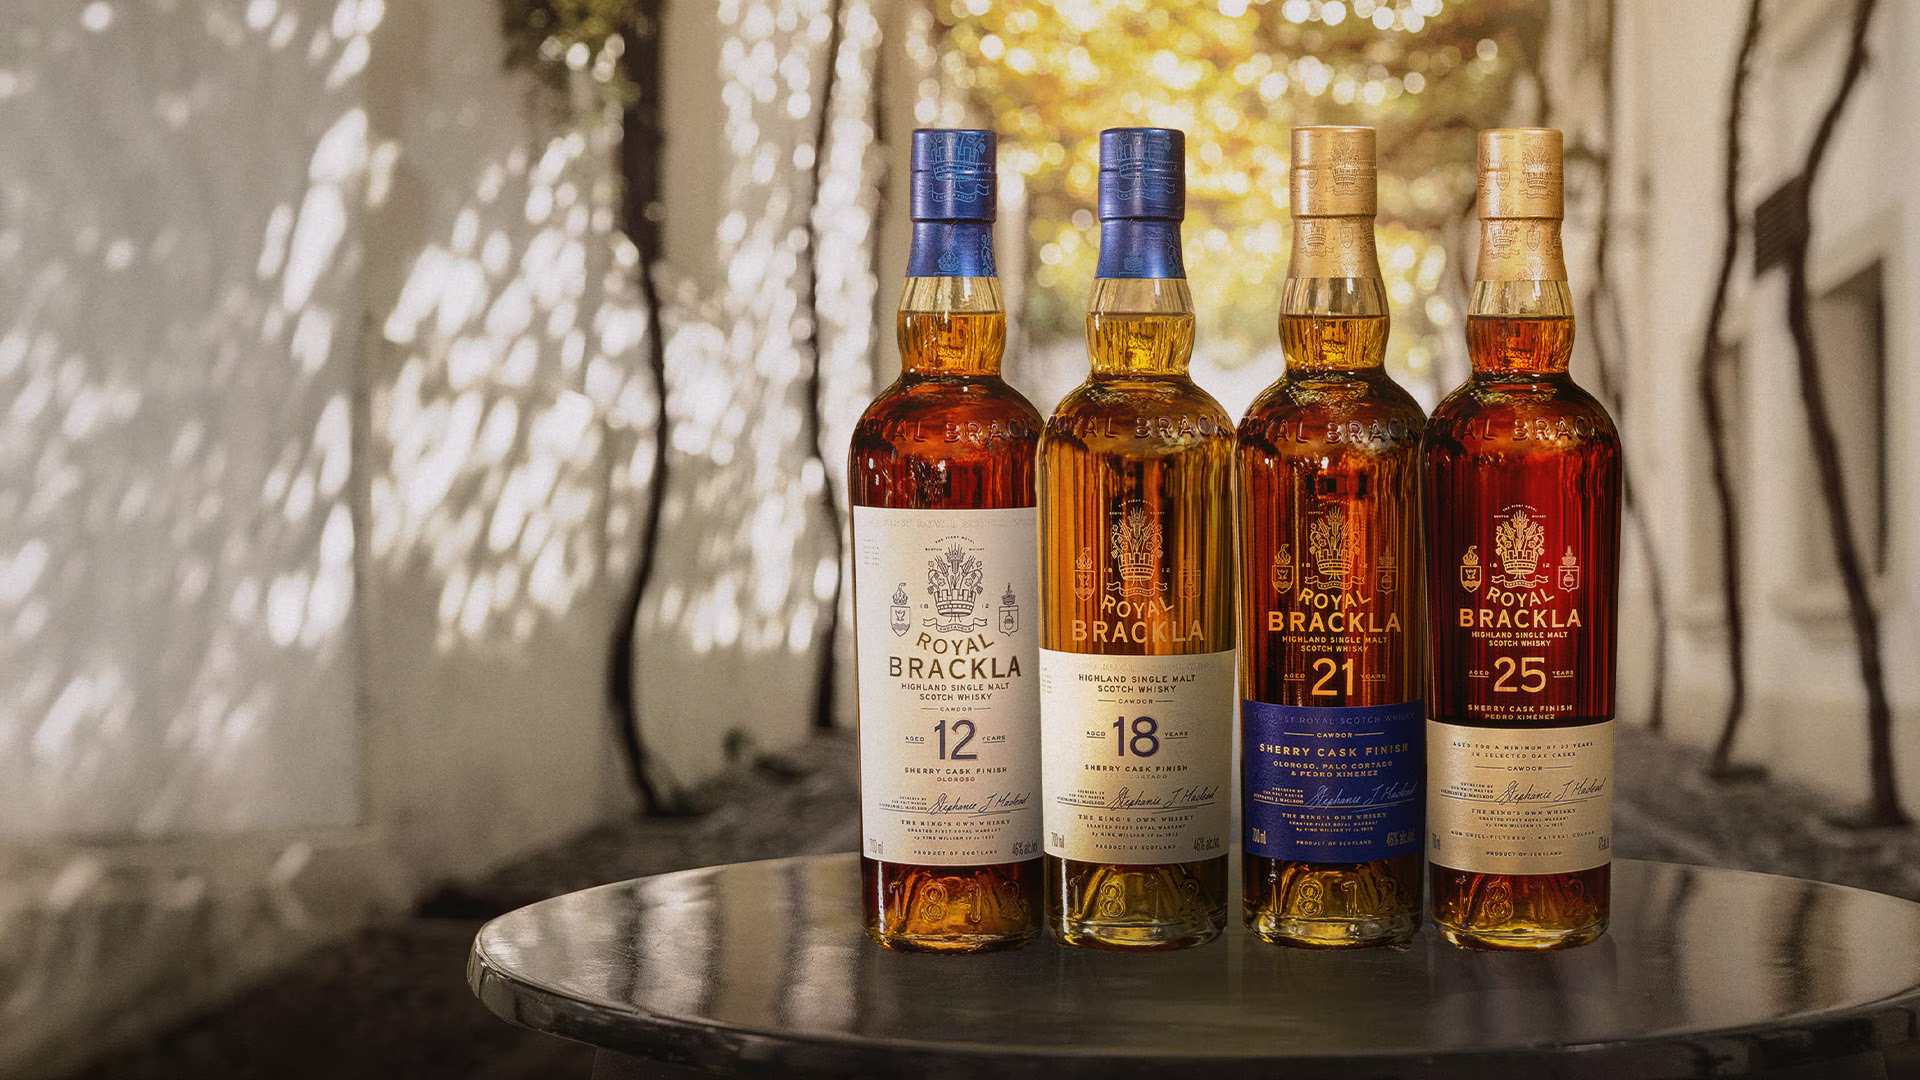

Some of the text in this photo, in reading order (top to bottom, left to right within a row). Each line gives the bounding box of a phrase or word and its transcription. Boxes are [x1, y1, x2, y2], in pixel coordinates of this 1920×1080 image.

[1101, 594, 1174, 619] ROYAL
[1299, 588, 1371, 610] ROYAL
[1486, 587, 1555, 607] ROYAL
[1268, 611, 1401, 632] BRACKLA
[1459, 608, 1582, 628] BRACKLA
[1072, 620, 1204, 643] BRACKLA
[917, 632, 994, 655] ROYAL
[889, 656, 1021, 680] BRACKLA
[1078, 674, 1126, 682] HIGHLAND
[1172, 674, 1196, 682] MALT
[1312, 658, 1353, 696] 21
[1493, 657, 1547, 693] 25
[901, 683, 946, 691] HIGHLAND
[957, 693, 992, 701] WHISKY
[1098, 685, 1177, 693] SCOTCH WHISKY
[1468, 704, 1504, 712] SHERRY
[1540, 704, 1573, 712] FINISH
[1300, 712, 1415, 725] ROYAL SCOTCH WHISKY
[934, 719, 978, 760] 12
[1113, 716, 1160, 757] 18
[1260, 743, 1408, 757] SHERRY CASK FINISH
[905, 767, 941, 775] SHERRY
[1085, 764, 1120, 772] SHERRY
[1351, 761, 1392, 769] CORTADO
